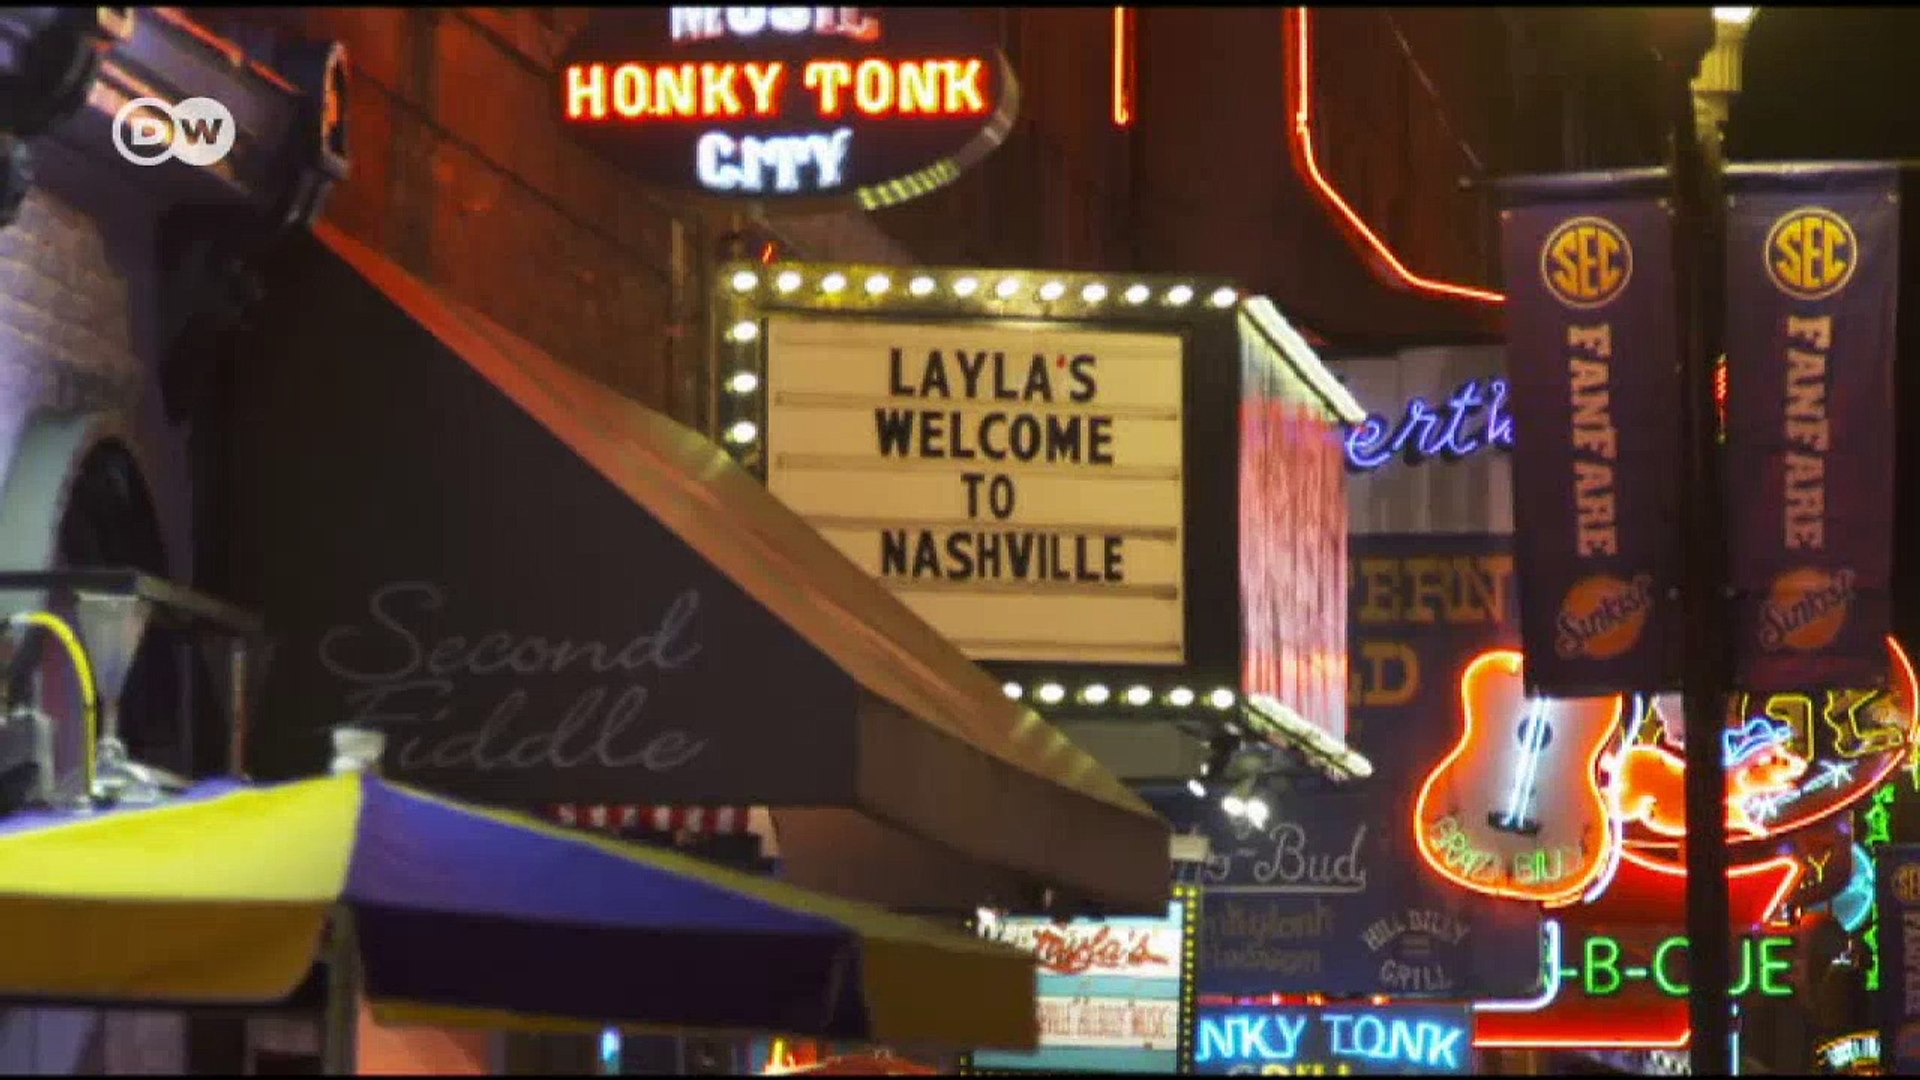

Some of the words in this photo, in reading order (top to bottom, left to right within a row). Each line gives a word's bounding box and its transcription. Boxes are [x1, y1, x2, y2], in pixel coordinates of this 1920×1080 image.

[567, 62, 785, 119] HONKY
[803, 59, 985, 114] TONK
[697, 129, 852, 192] CITY
[1553, 225, 1623, 296] SEC
[1775, 216, 1848, 289] SEC
[889, 347, 1098, 402] LAYLA'S
[875, 408, 1114, 464] WELCOME
[1566, 323, 1619, 558] FANFARE
[1784, 315, 1832, 551] FANFARE
[960, 472, 1016, 519] TO
[881, 530, 1125, 582] NASHVILLE
[1348, 554, 1514, 624] ERN
[318, 579, 705, 682] Second
[1194, 1013, 1308, 1062] NKY
[1320, 1012, 1465, 1070] TONK
